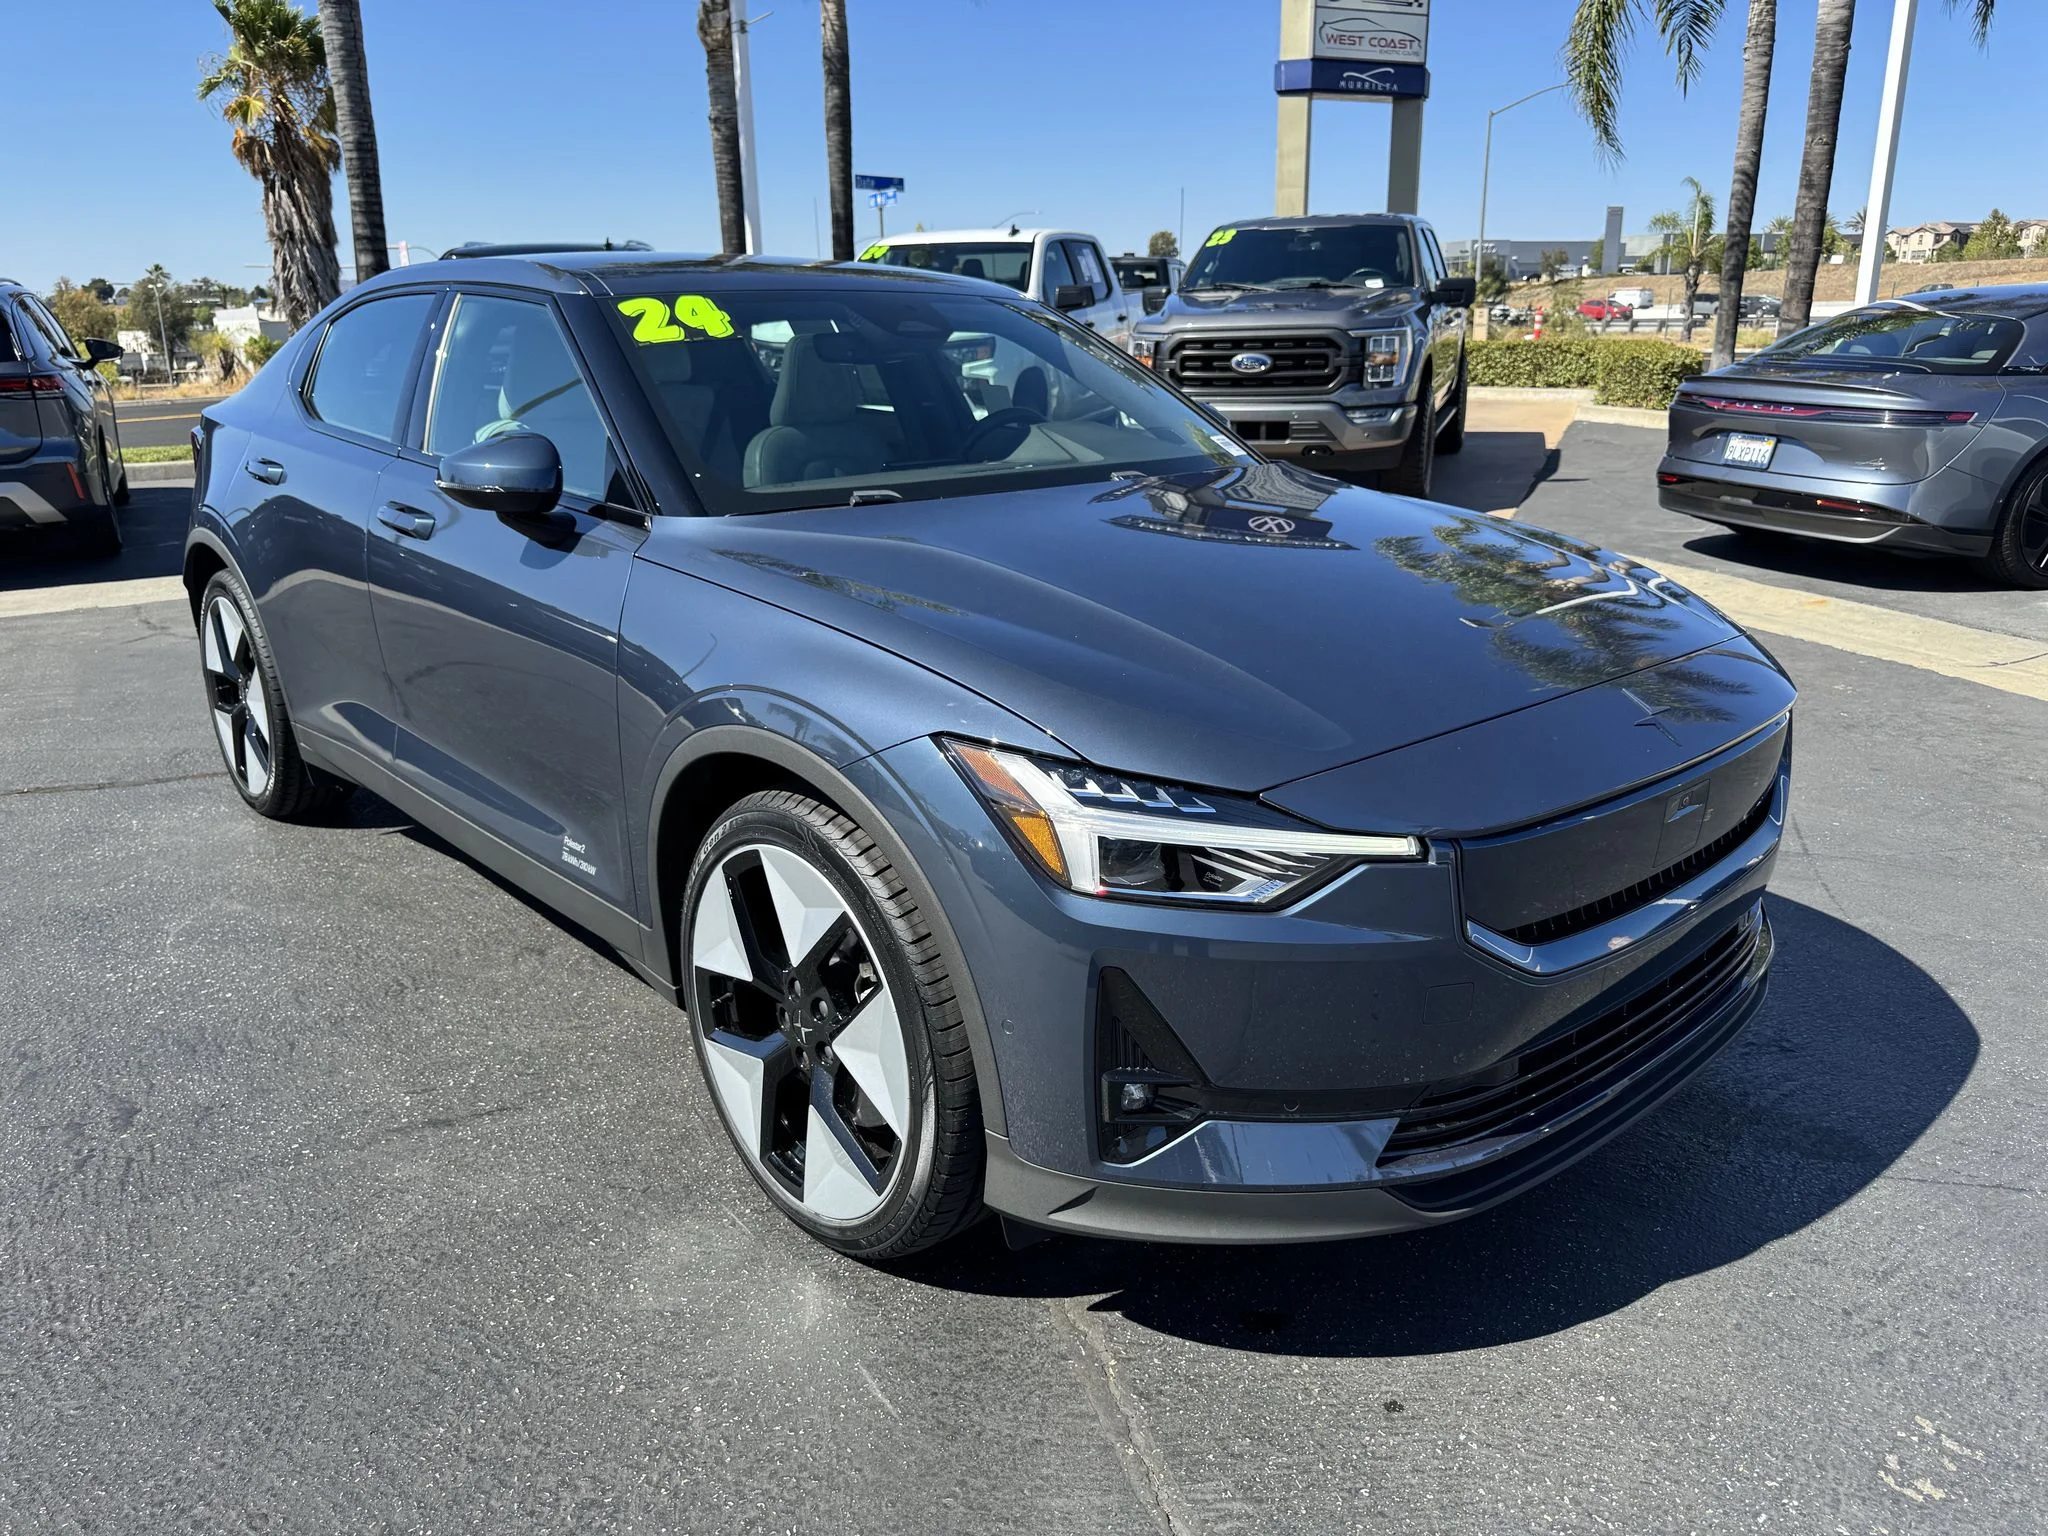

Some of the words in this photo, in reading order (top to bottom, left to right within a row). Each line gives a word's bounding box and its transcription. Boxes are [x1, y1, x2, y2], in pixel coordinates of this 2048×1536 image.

[1325, 32, 1364, 46] WEST
[1368, 36, 1416, 49] COAST
[1339, 80, 1399, 91] MURRIETA
[617, 295, 735, 344] 24
[1720, 400, 1795, 413] LUCID
[1726, 444, 1770, 464] 9LXP116
